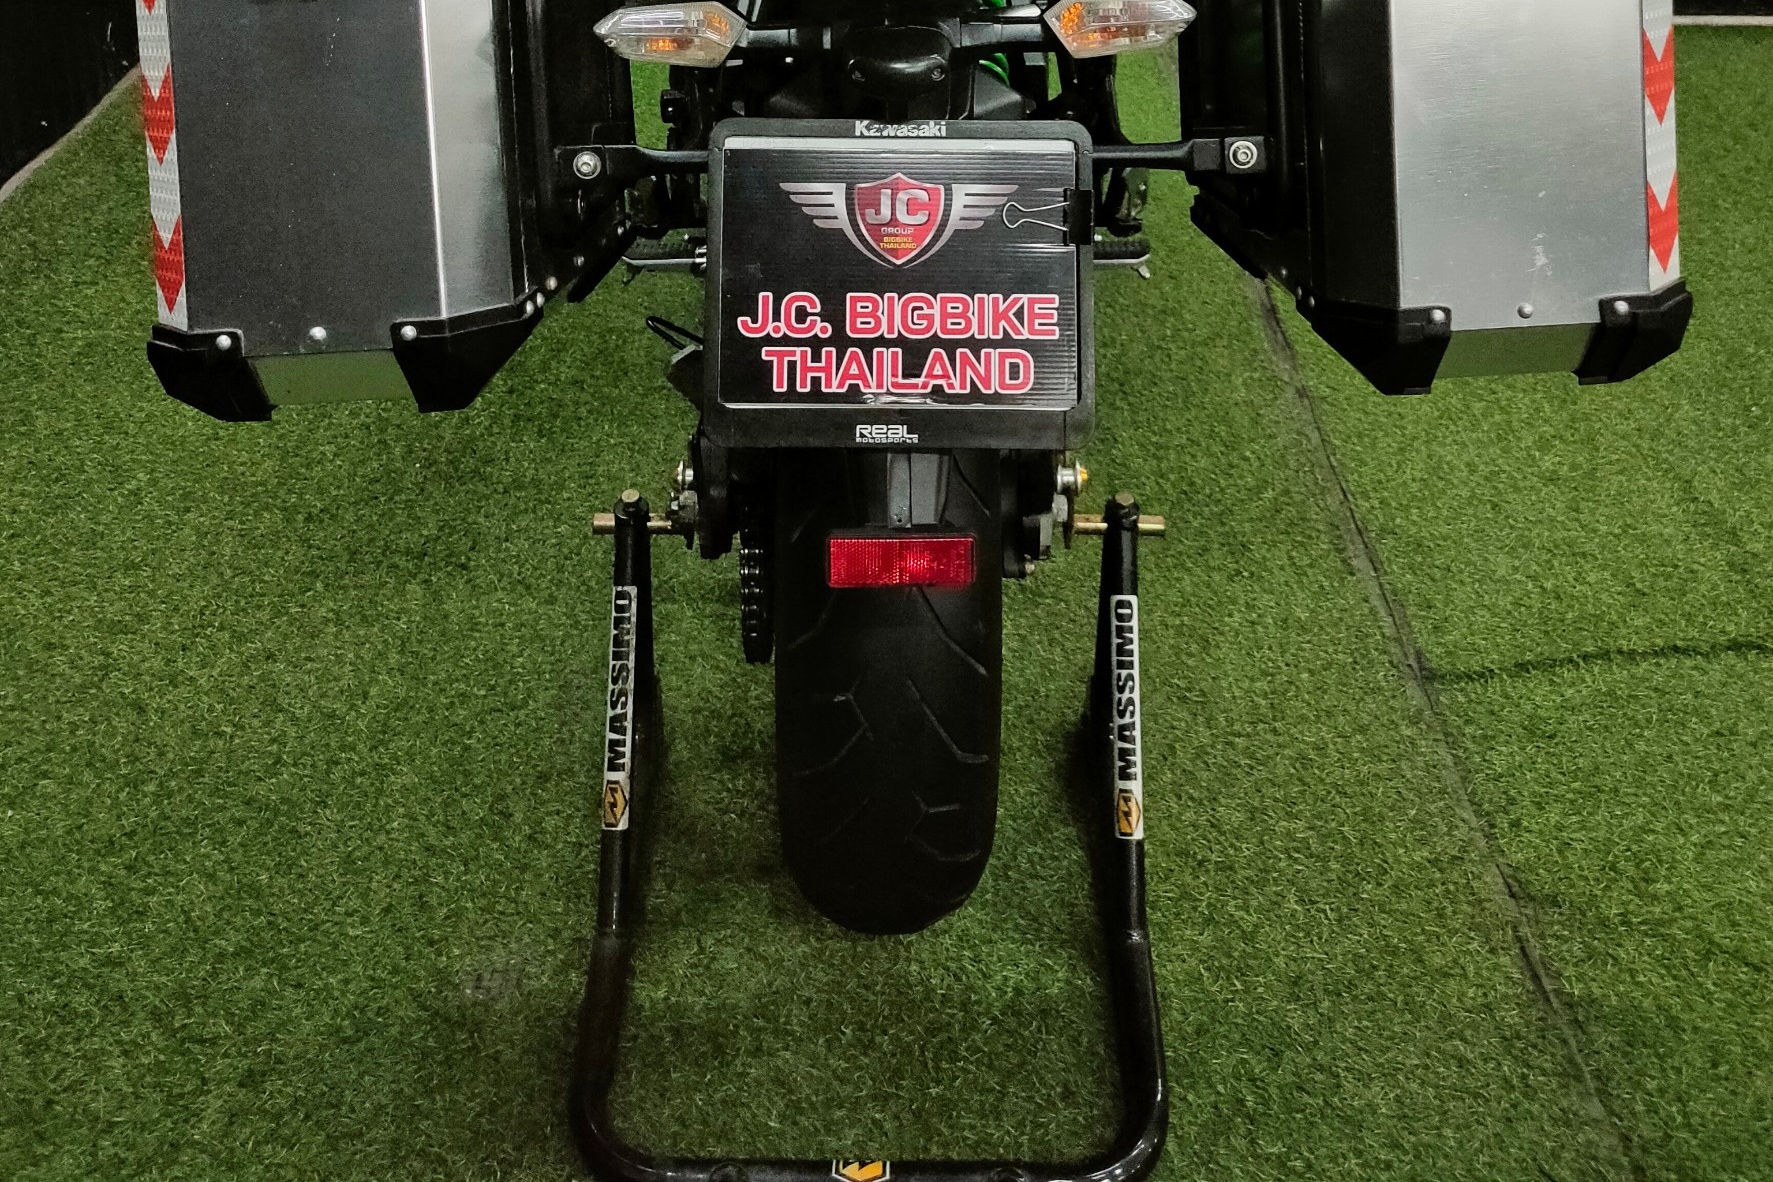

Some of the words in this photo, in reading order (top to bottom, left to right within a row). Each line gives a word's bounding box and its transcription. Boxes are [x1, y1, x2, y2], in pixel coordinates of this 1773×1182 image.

[855, 120, 947, 137] Kawasaki
[864, 188, 930, 225] JC
[881, 227, 914, 235] GROUP
[737, 291, 832, 338] J.C.
[846, 293, 1060, 339] BIGBIKE
[762, 347, 1035, 394] THAILAND
[606, 586, 633, 773] MASSIMO
[1114, 599, 1138, 781] MASSIMO
